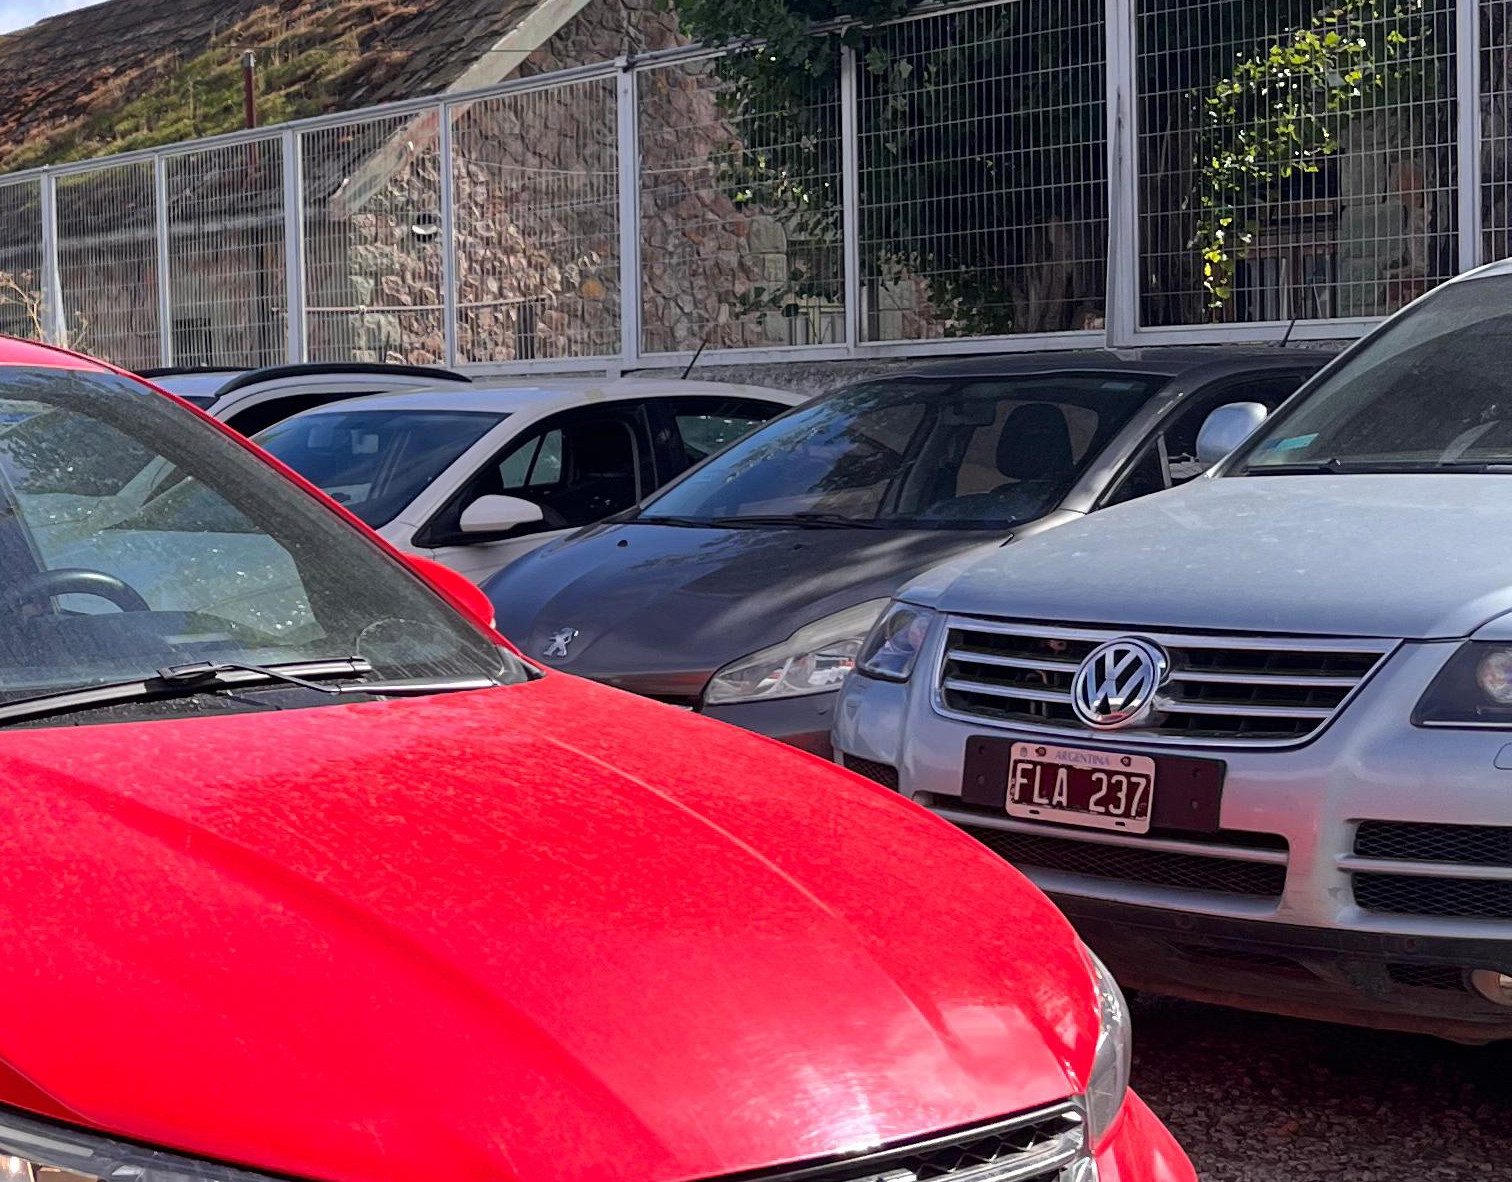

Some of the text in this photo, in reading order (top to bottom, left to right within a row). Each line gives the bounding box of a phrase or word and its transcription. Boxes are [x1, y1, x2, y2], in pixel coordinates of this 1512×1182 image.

[1055, 750, 1111, 766] ARGENTINA
[1013, 763, 1147, 818] FLA 237
